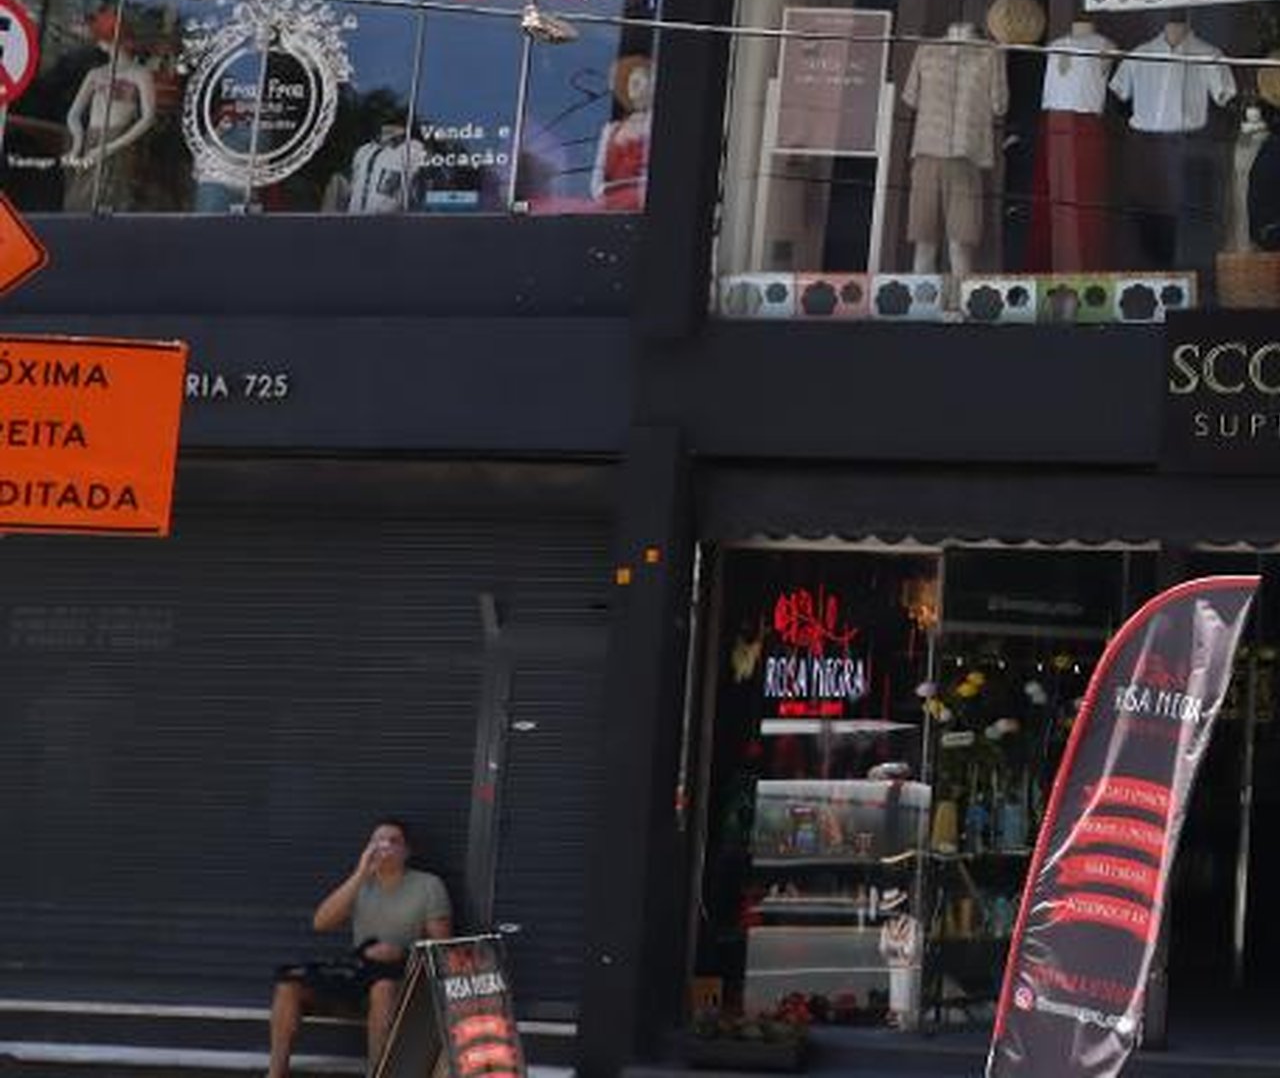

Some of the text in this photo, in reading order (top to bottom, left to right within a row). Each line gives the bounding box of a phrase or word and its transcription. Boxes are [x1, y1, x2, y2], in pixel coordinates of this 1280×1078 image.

[420, 123, 510, 141] Venda e
[417, 149, 509, 170] Locação
[245, 375, 288, 398] 725
[0, 420, 88, 448] EITA
[764, 657, 809, 698] ROSA
